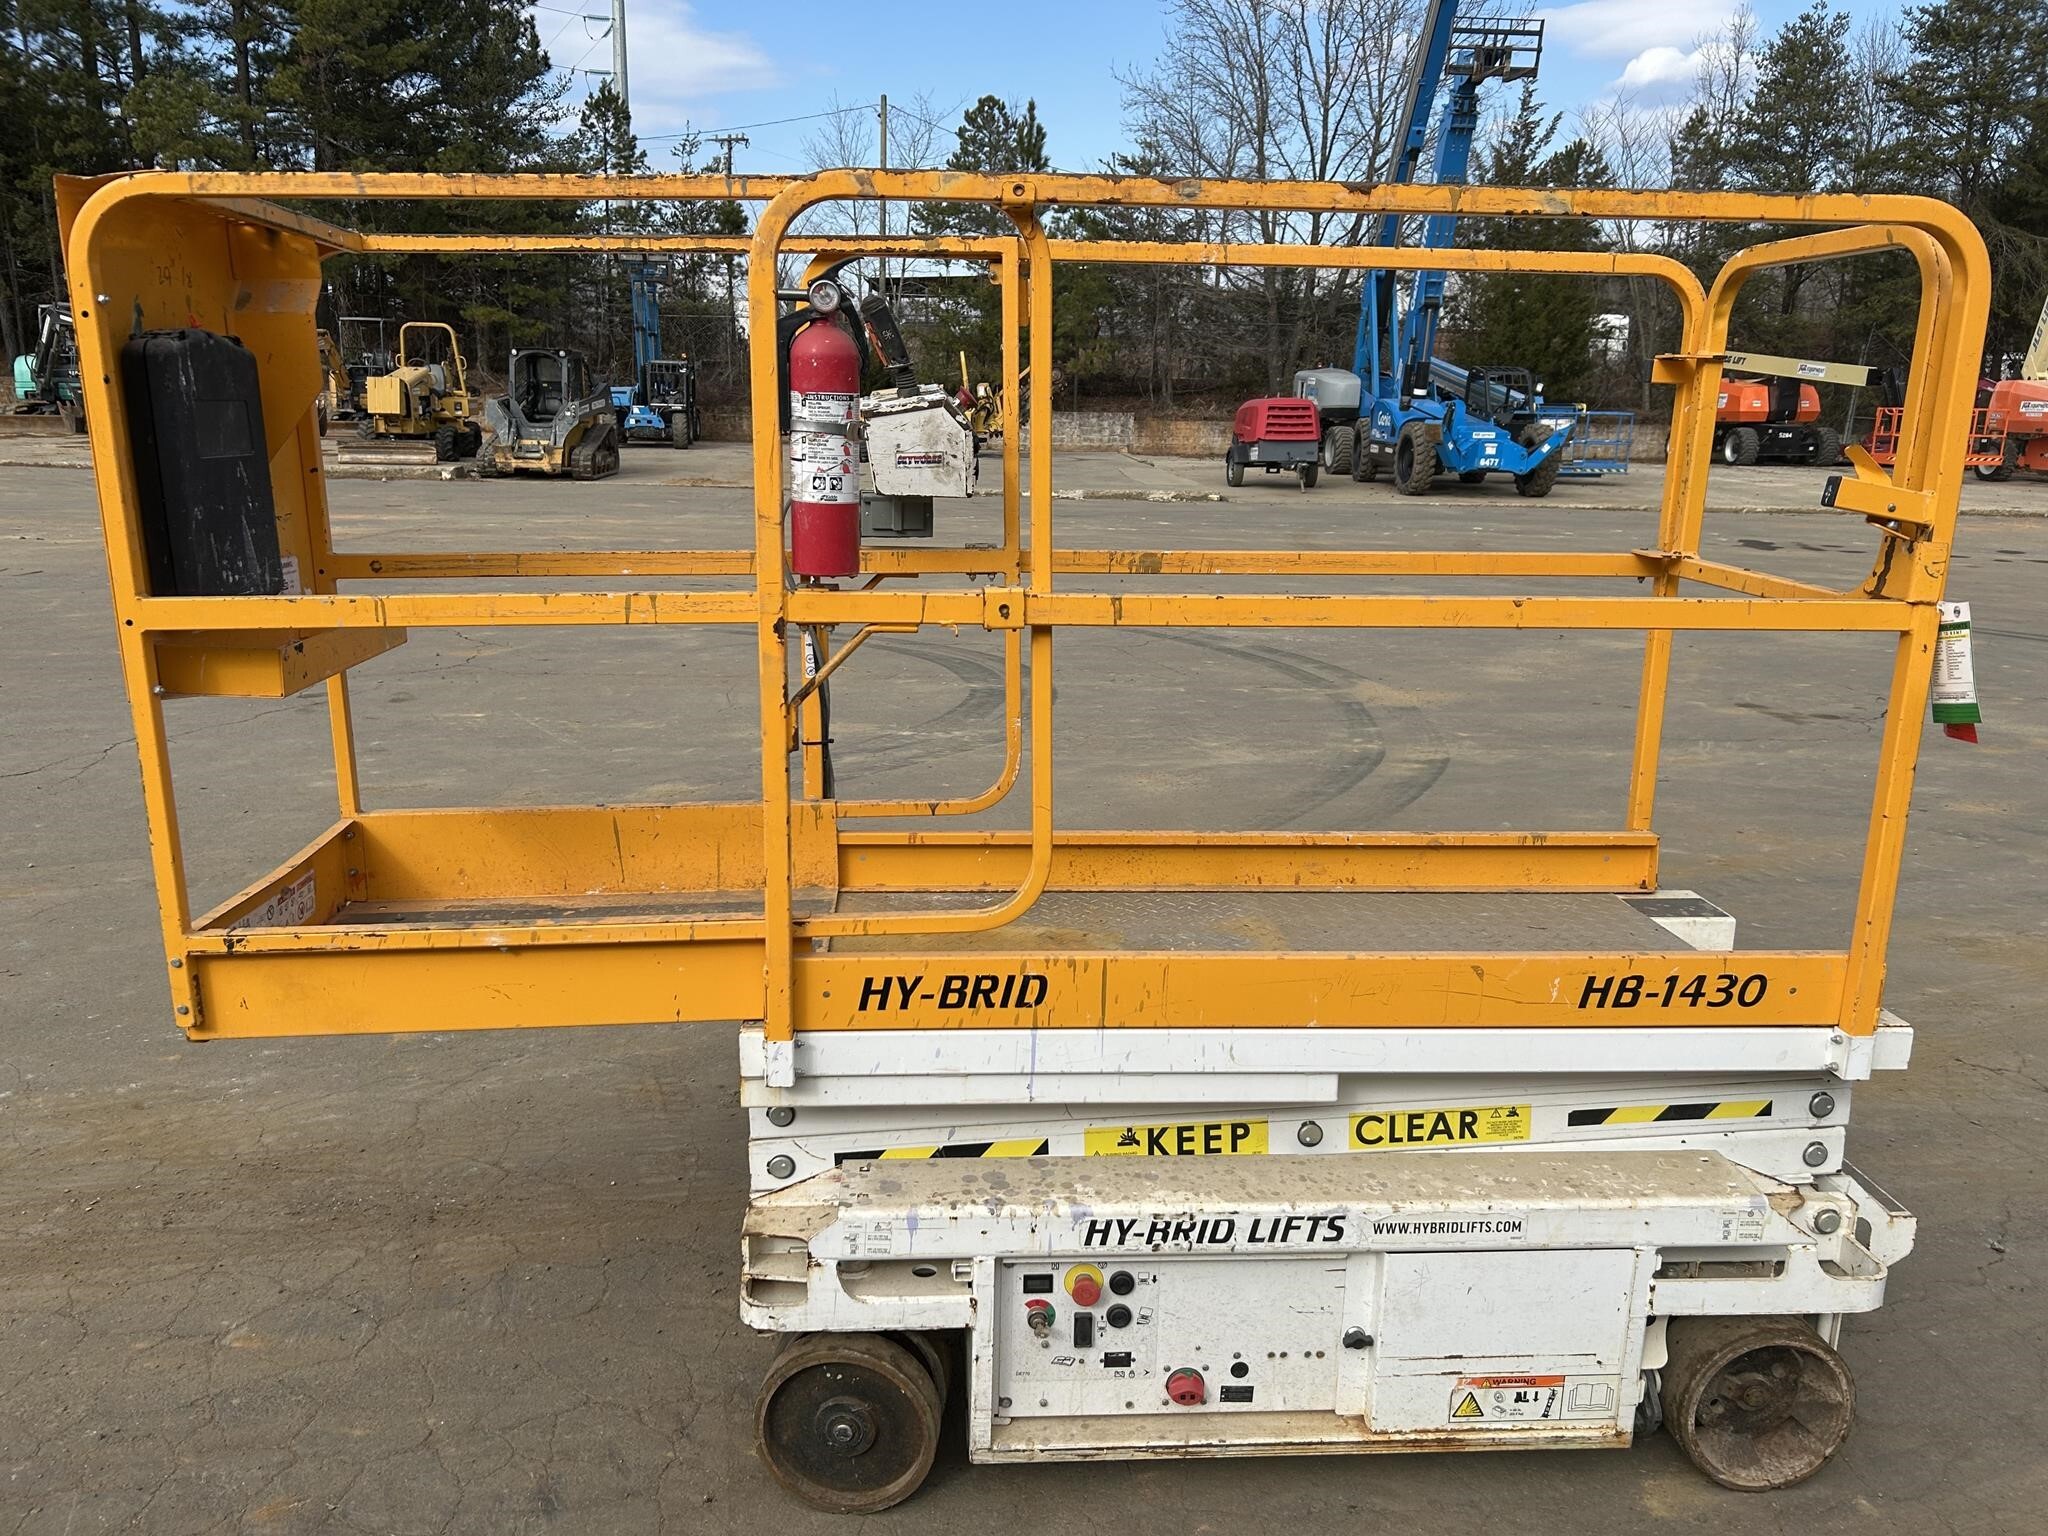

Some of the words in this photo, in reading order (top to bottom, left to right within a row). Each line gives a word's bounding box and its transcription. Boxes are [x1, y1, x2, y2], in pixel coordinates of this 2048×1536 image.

[858, 974, 1048, 1011] HY-BRID
[1577, 974, 1768, 1009] HB-1430
[1147, 1122, 1250, 1156] KEEP
[1355, 1110, 1478, 1145] CLEAR
[1084, 1218, 1235, 1246] HY-BRID
[1247, 1215, 1347, 1243] LIFTS
[1372, 1220, 1522, 1235] WWW.HYBRIDLIFTS.COM
[1492, 1377, 1537, 1386] WARNING
